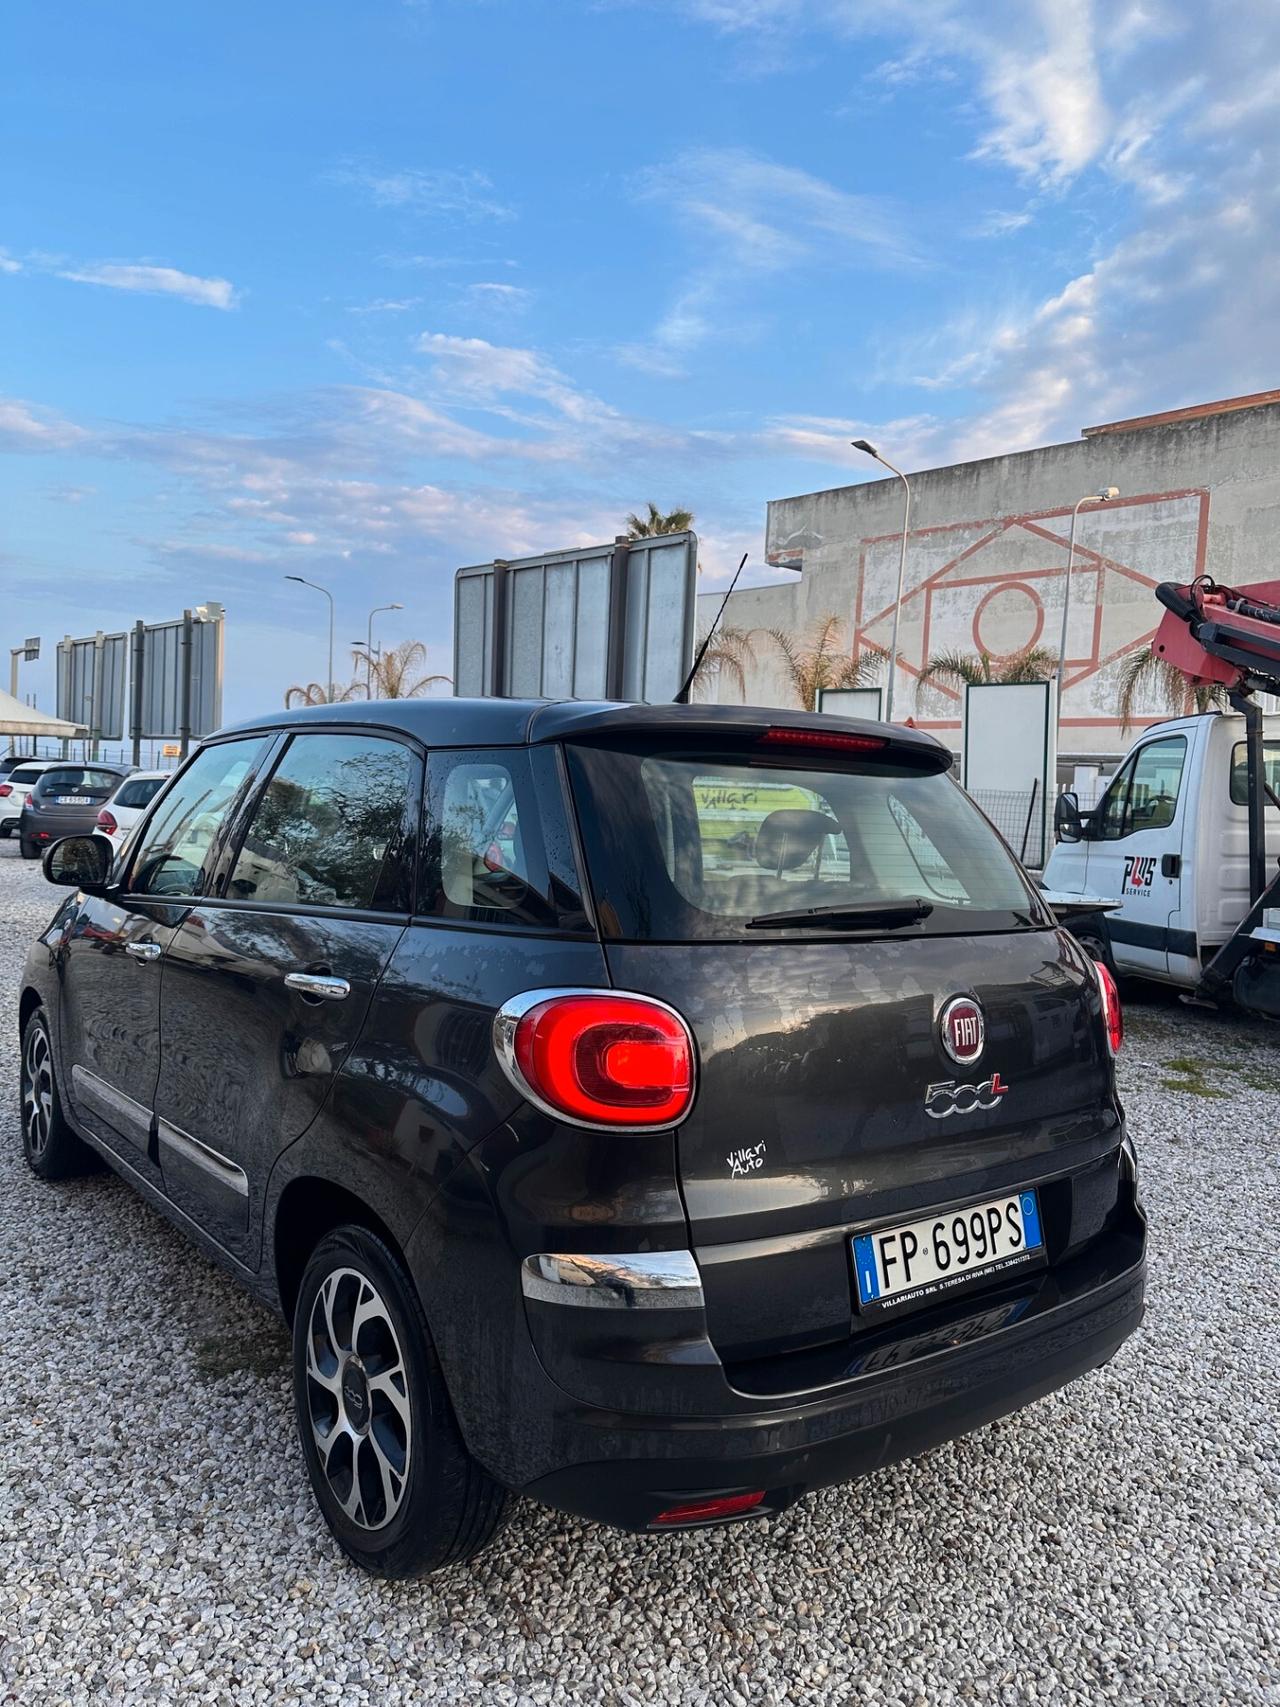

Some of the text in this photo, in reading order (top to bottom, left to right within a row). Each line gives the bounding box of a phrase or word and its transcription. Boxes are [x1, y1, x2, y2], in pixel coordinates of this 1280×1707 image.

[1121, 856, 1157, 895] PLUS
[1126, 888, 1151, 897] SERVICE
[954, 1016, 977, 1047] FIAT
[726, 1139, 767, 1168] Villari
[732, 1157, 763, 1180] Auto
[882, 1289, 924, 1309] VILLARIAUTO
[925, 1285, 938, 1296] SRL
[972, 1270, 984, 1279] RIVA
